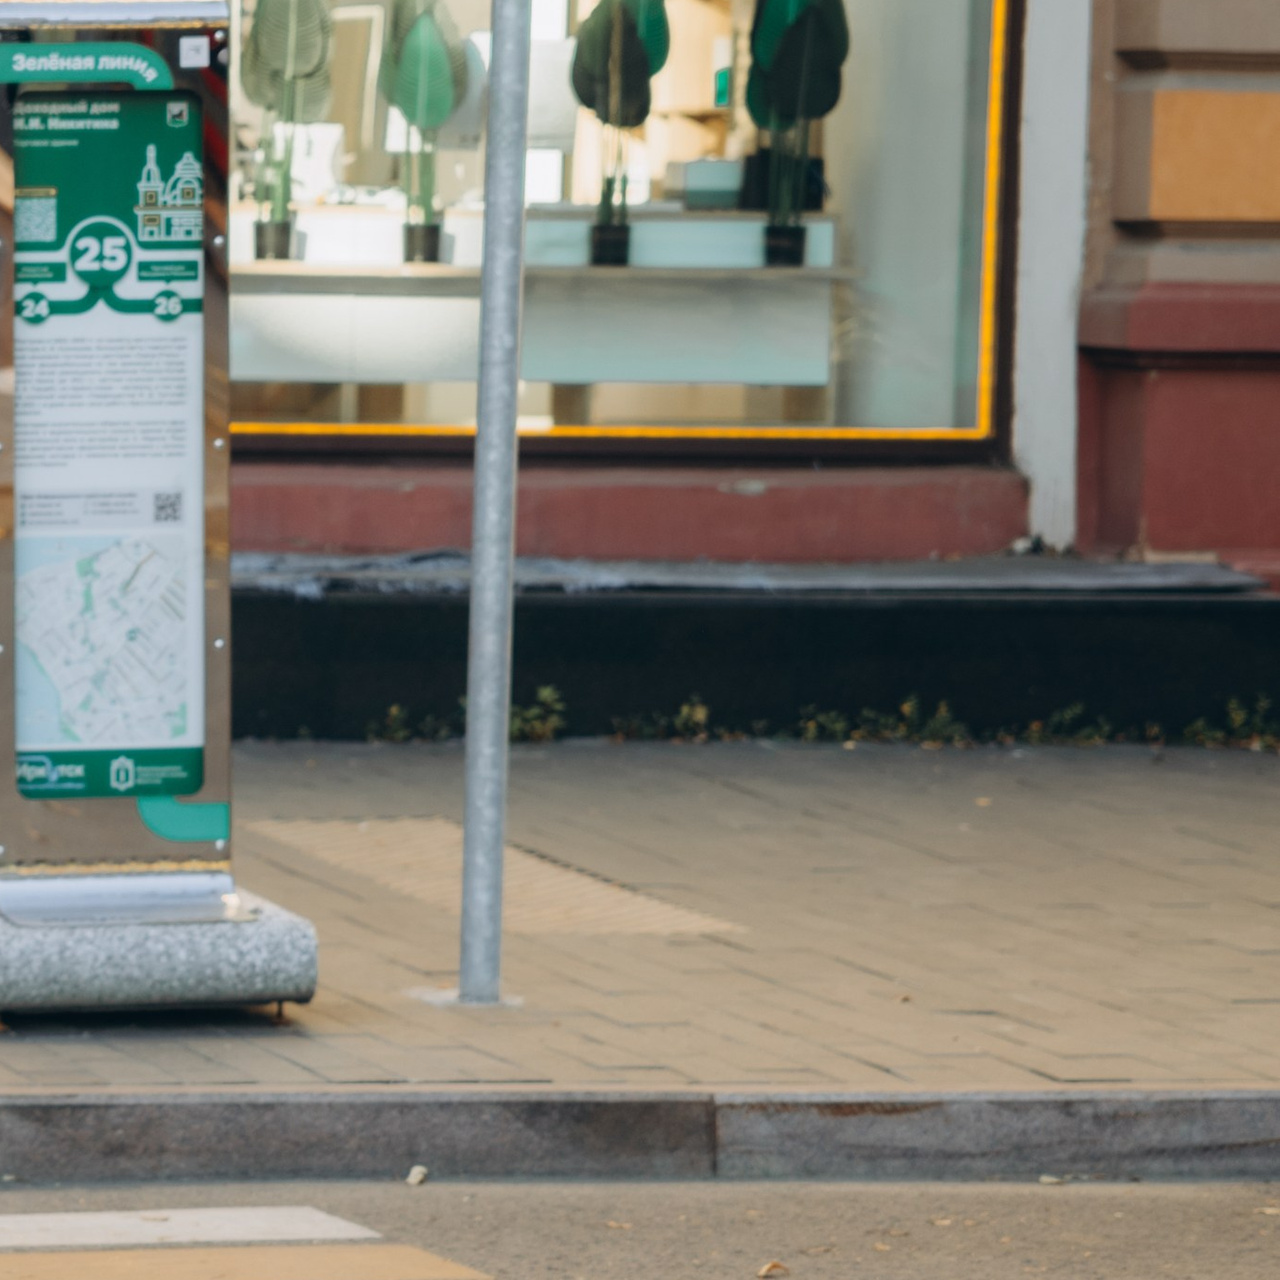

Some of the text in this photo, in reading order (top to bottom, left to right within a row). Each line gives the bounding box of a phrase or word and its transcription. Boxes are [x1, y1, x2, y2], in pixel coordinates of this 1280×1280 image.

[12, 52, 158, 83] Зелёная линия
[74, 236, 128, 272] 25
[21, 296, 183, 318] 24 26
